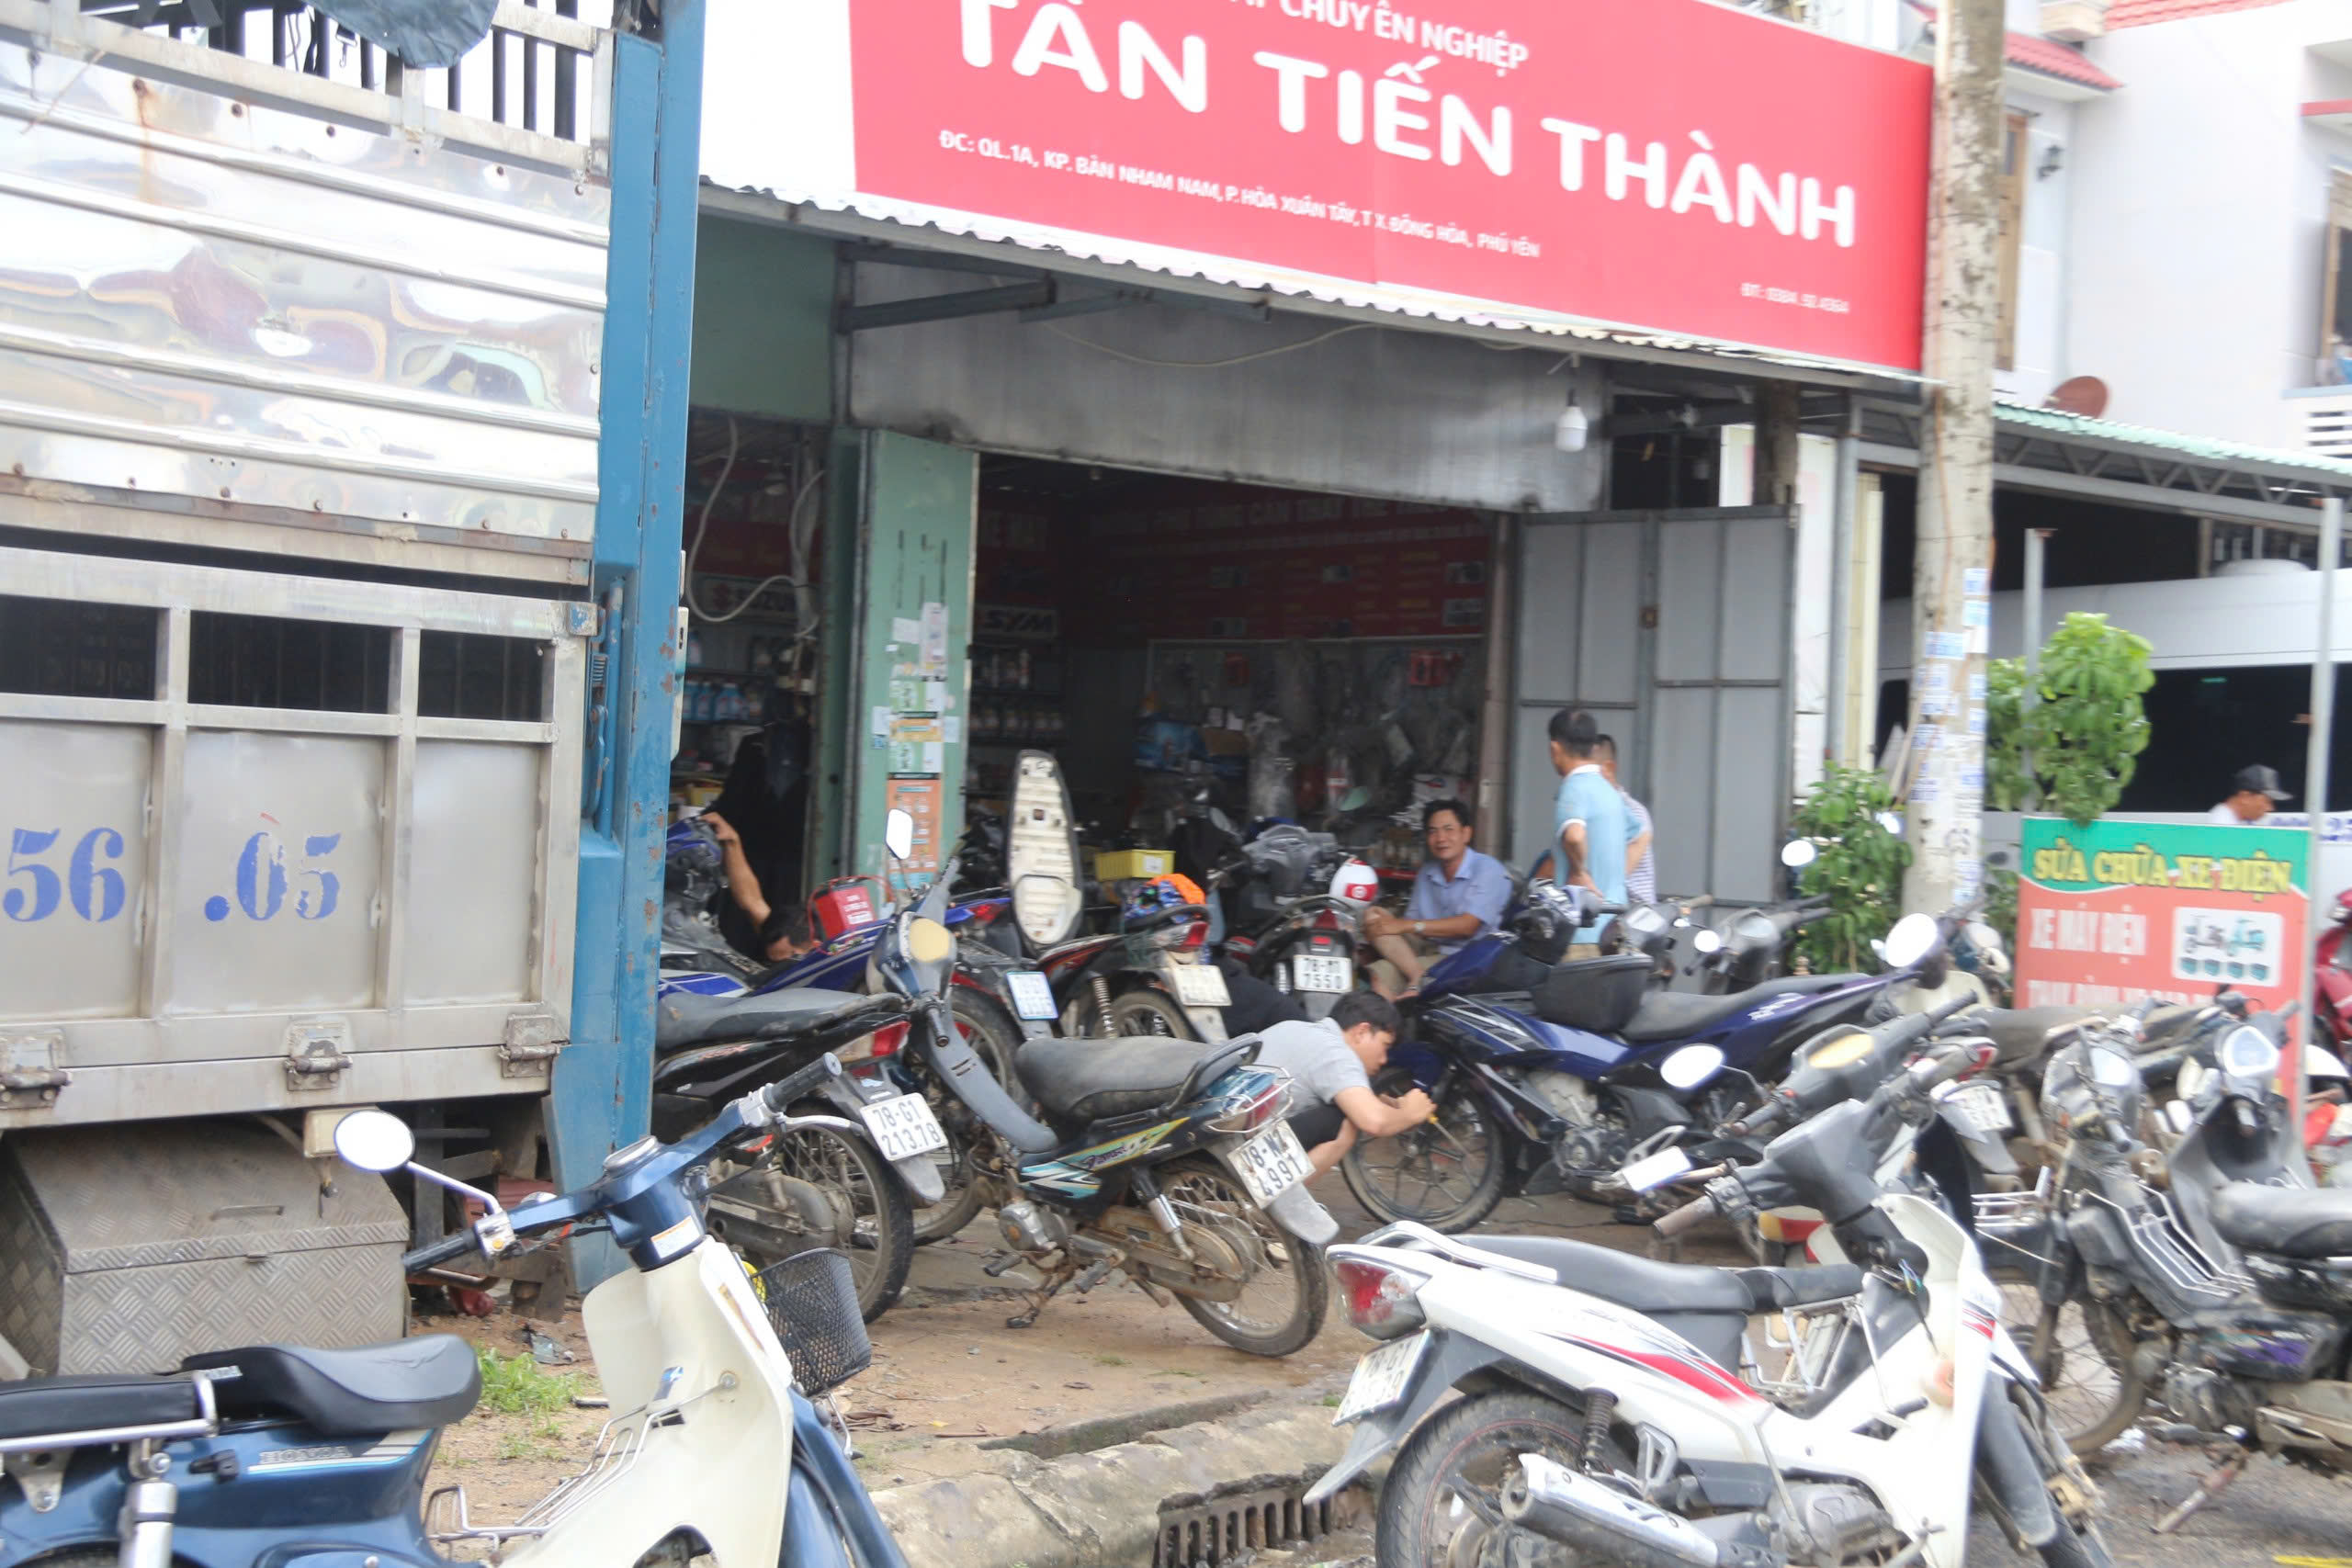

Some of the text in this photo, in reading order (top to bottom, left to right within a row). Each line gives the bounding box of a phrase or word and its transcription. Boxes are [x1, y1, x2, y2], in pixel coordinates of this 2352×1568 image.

[1421, 21, 1529, 77] NGHIỆP
[1253, 56, 1513, 176] TIẾN
[1541, 117, 1854, 248] THÀNH
[3, 828, 126, 922] 56
[882, 1122, 941, 1156] 213.78
[259, 1446, 353, 1465] HONDA
